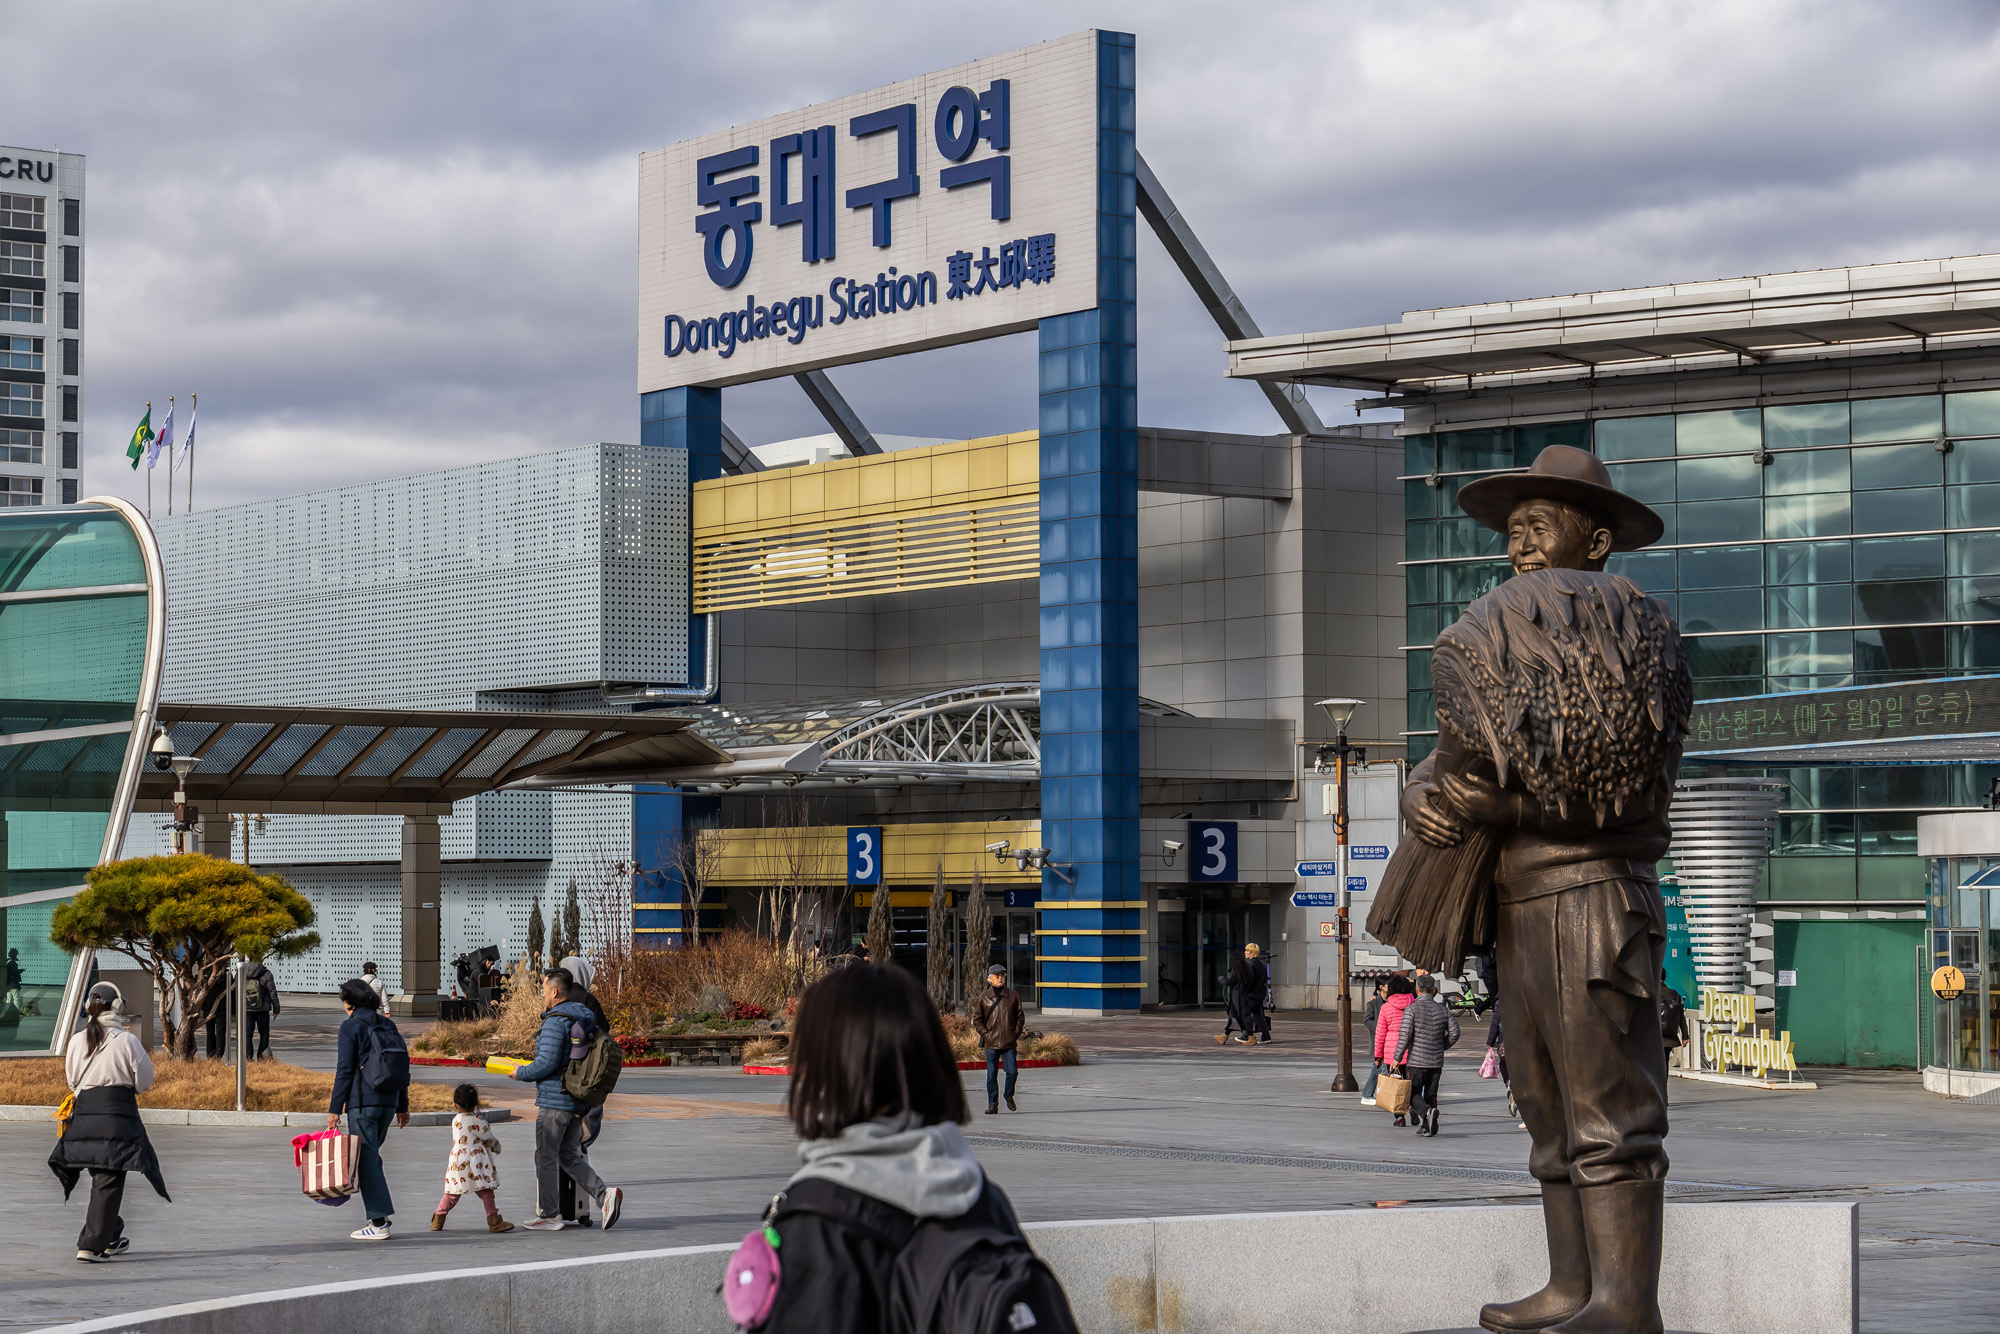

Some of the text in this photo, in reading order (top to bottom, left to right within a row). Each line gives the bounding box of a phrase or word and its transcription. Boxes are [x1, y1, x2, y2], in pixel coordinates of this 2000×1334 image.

[695, 79, 1010, 288] 동대구역
[946, 233, 1056, 299] 東大邱驛
[664, 266, 937, 358] Dongdaegu Station
[1794, 703, 1838, 737] (매주
[1847, 695, 1902, 731] 월요일
[1915, 689, 1972, 725] 운휴)
[856, 833, 874, 879] 3
[1201, 827, 1227, 876] 3
[858, 893, 864, 906] 3
[1009, 891, 1015, 905] 3
[1704, 987, 1754, 1033] Daegu
[1704, 1025, 1794, 1077] Gyeongbuk
